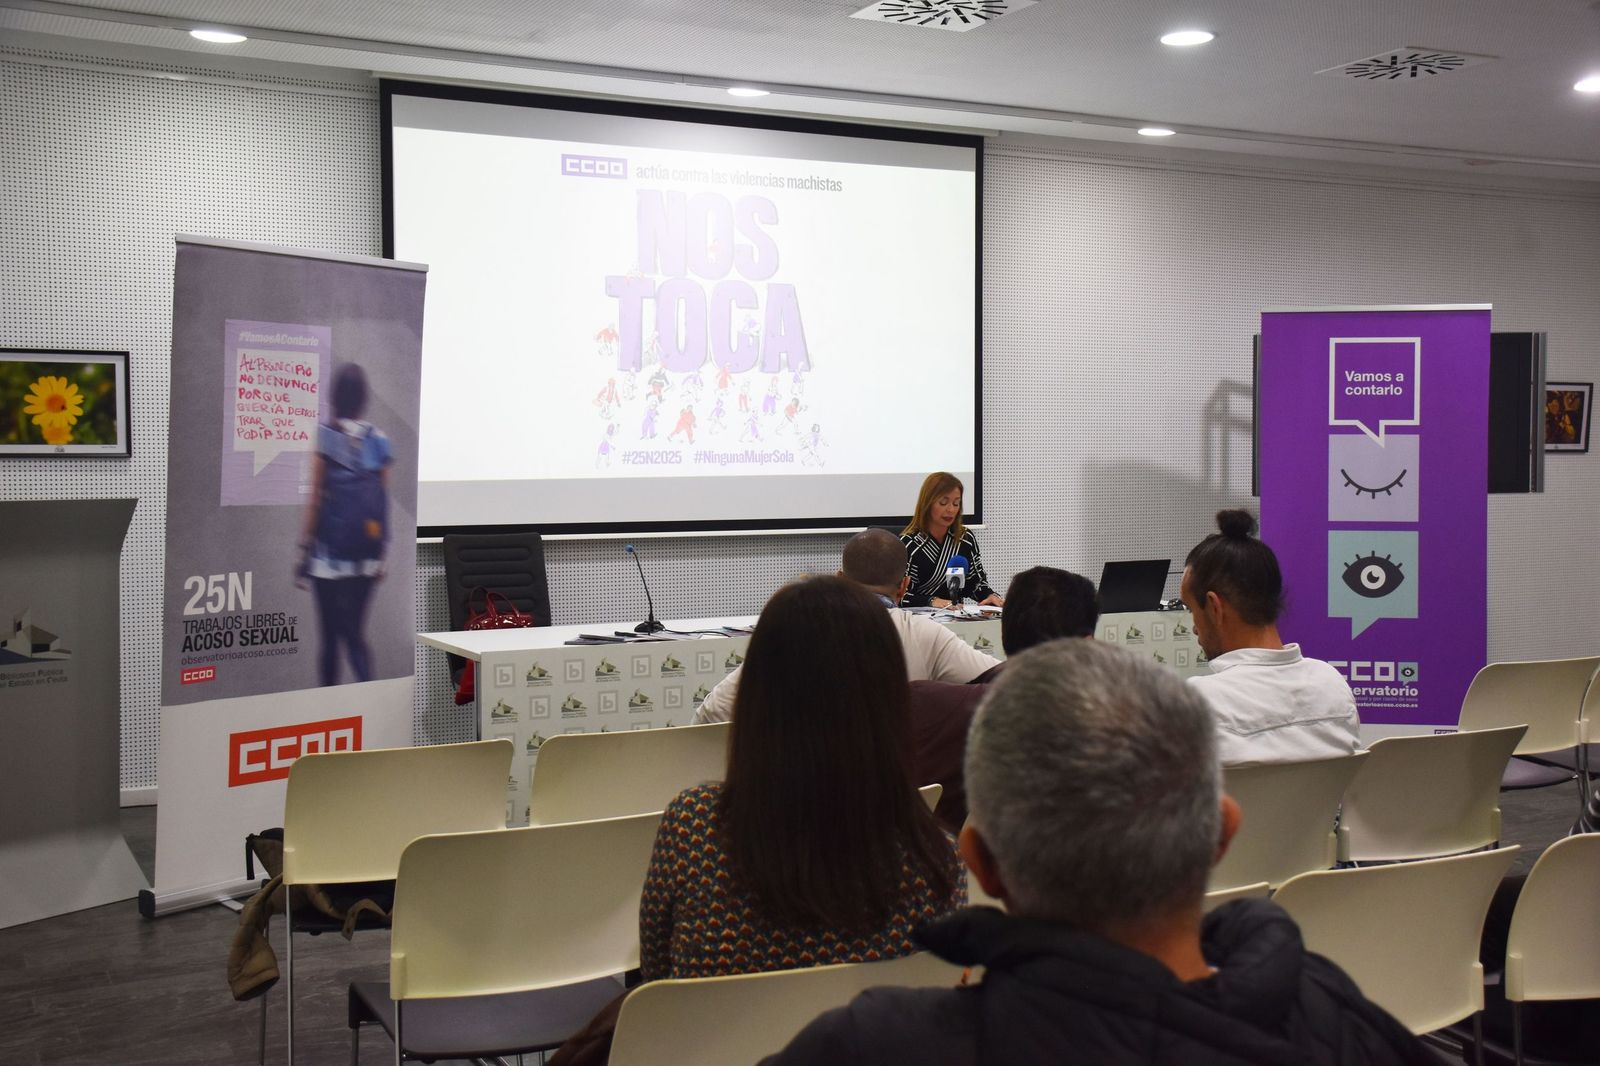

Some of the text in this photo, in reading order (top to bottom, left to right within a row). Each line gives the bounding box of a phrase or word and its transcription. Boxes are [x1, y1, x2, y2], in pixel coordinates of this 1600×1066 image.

[564, 156, 843, 192] CCOO actúa contra las violencias machistas
[636, 188, 779, 281] NOS
[605, 275, 811, 374] TOCA
[240, 374, 254, 384] NO
[1344, 370, 1404, 382] Vamos a
[1344, 384, 1403, 395] contarlo
[272, 418, 295, 427] QUE
[276, 430, 308, 440] SOLA
[622, 449, 794, 466] #25N2025 #NingunaMujerSola
[183, 571, 253, 616] 25N
[182, 612, 298, 635] TRABAJOS LIBRES DE
[181, 625, 299, 653] ACOSO SEXUAL
[181, 646, 298, 666] observatorioacoso.ccoo.es
[183, 669, 214, 681] CCOO
[1350, 685, 1418, 697] ervatorio
[239, 728, 354, 775] CCOO
